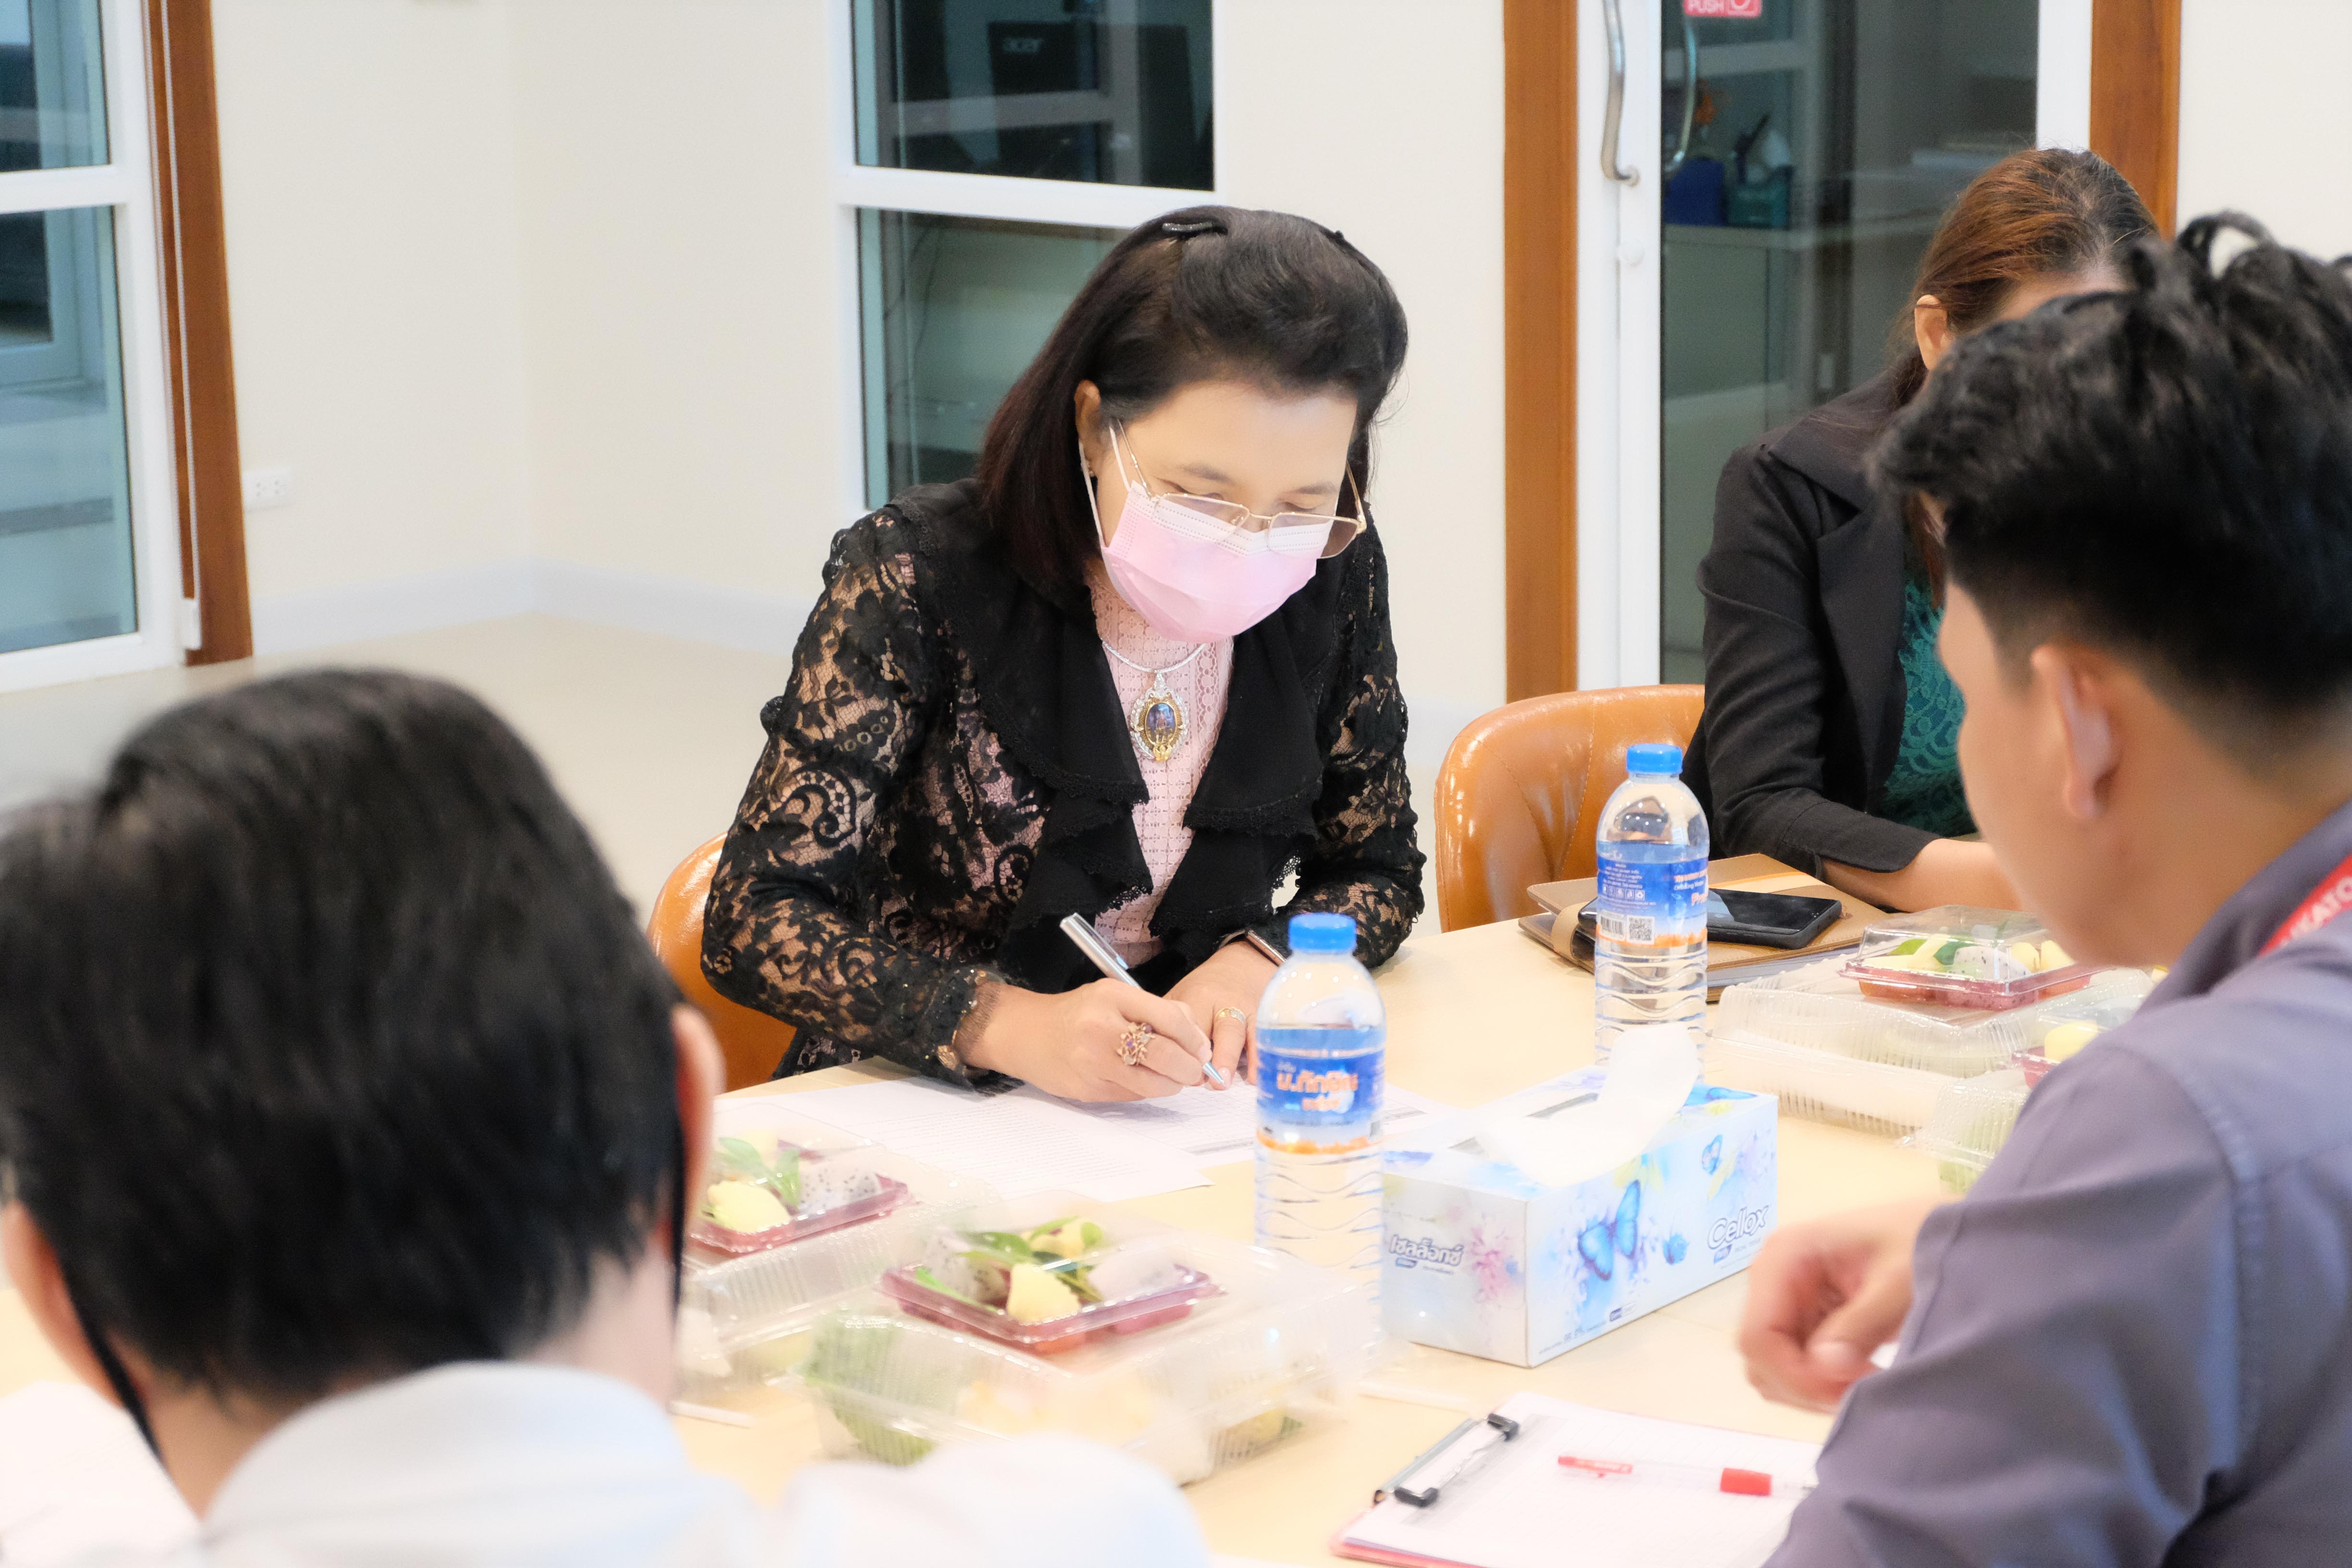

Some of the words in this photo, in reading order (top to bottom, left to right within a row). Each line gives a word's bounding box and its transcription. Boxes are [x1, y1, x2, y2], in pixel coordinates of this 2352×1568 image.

[1688, 0, 1725, 13] PUSH
[1707, 1205, 1769, 1250] Cellox
[1389, 1234, 1464, 1266] เซลล็อกซ์
